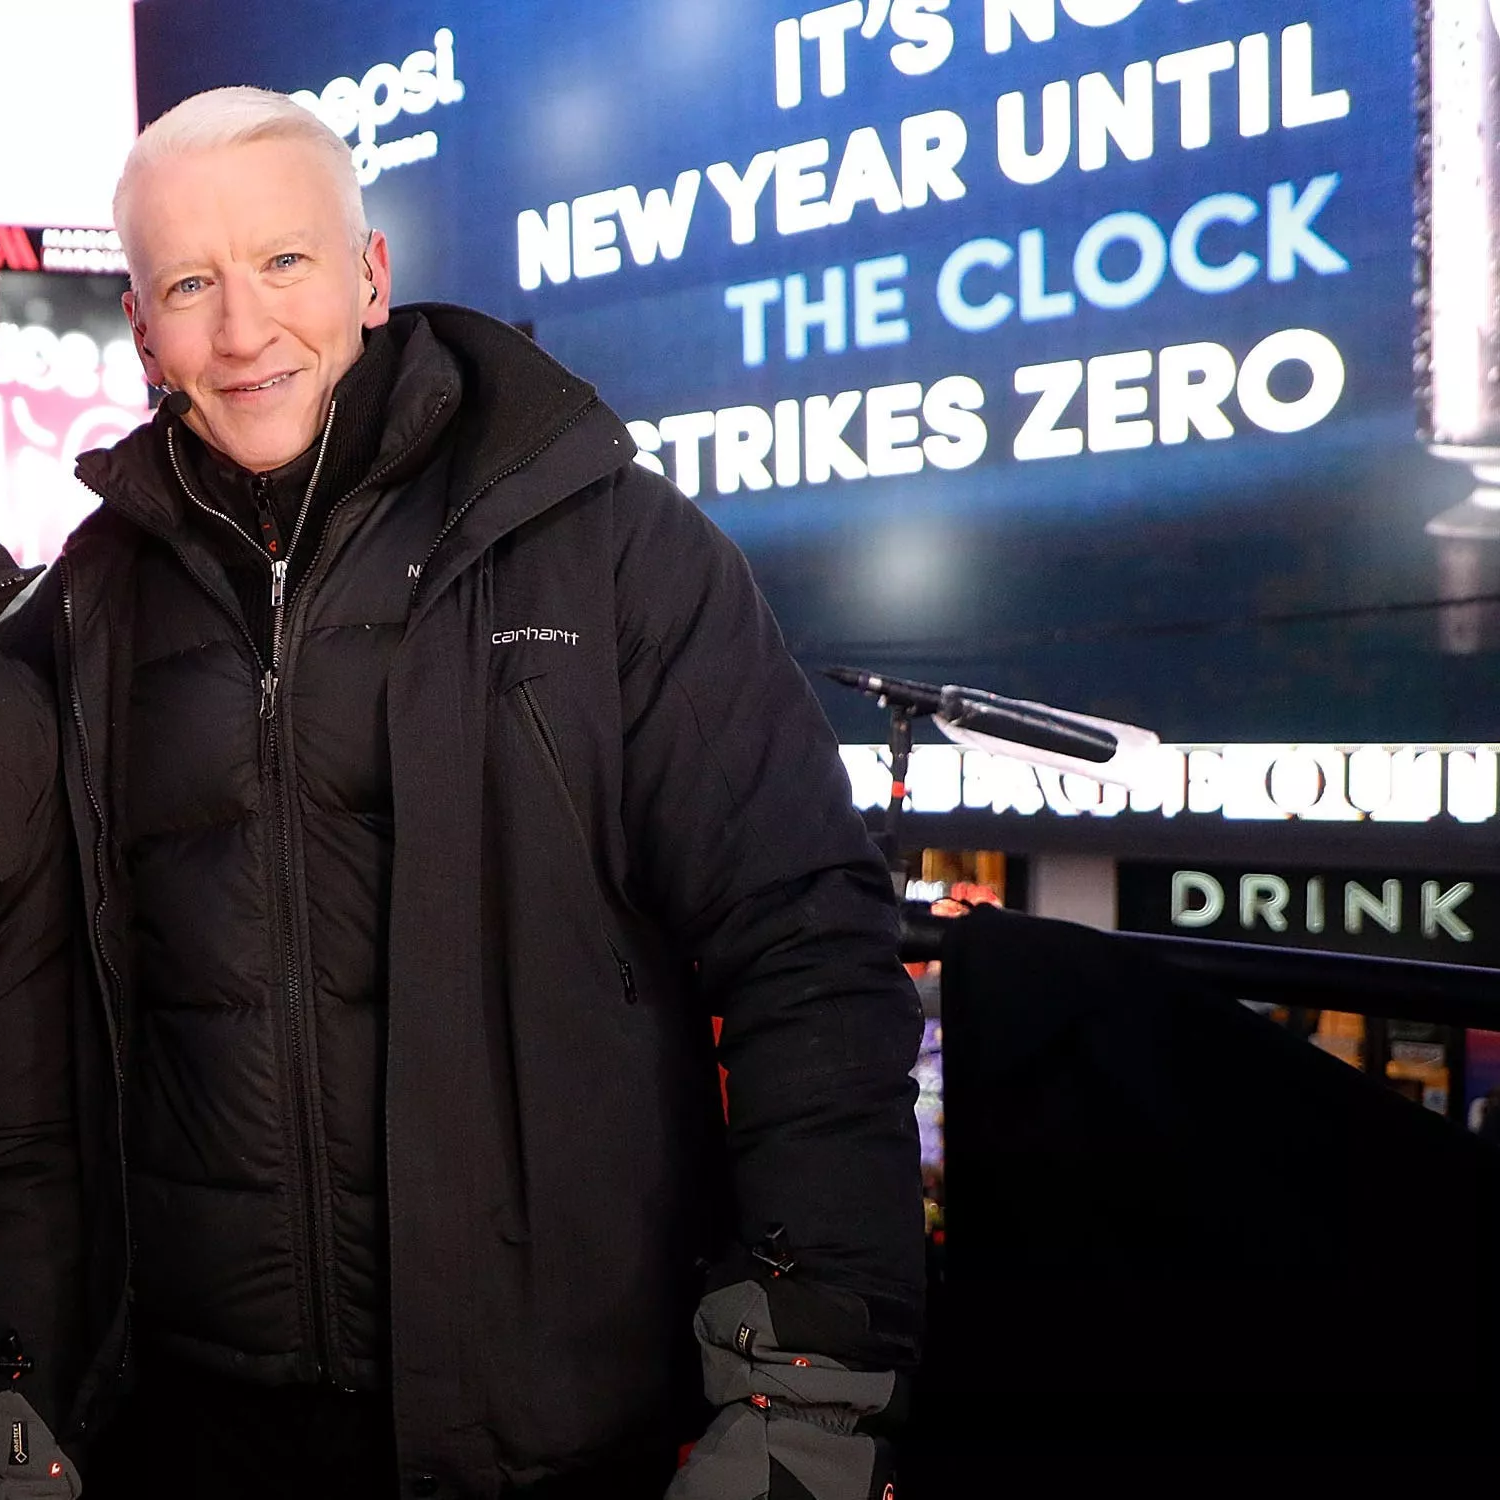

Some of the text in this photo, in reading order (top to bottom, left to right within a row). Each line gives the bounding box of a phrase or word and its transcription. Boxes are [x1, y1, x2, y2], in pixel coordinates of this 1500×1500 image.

[774, 0, 955, 110] IT'S
[517, 21, 1351, 291] NEW YEAR UNTIL
[723, 172, 1350, 367] THE CLOCK
[625, 327, 1346, 499] STRIKES ZERO
[491, 626, 580, 646] carhartt
[1171, 870, 1473, 942] DRINK
